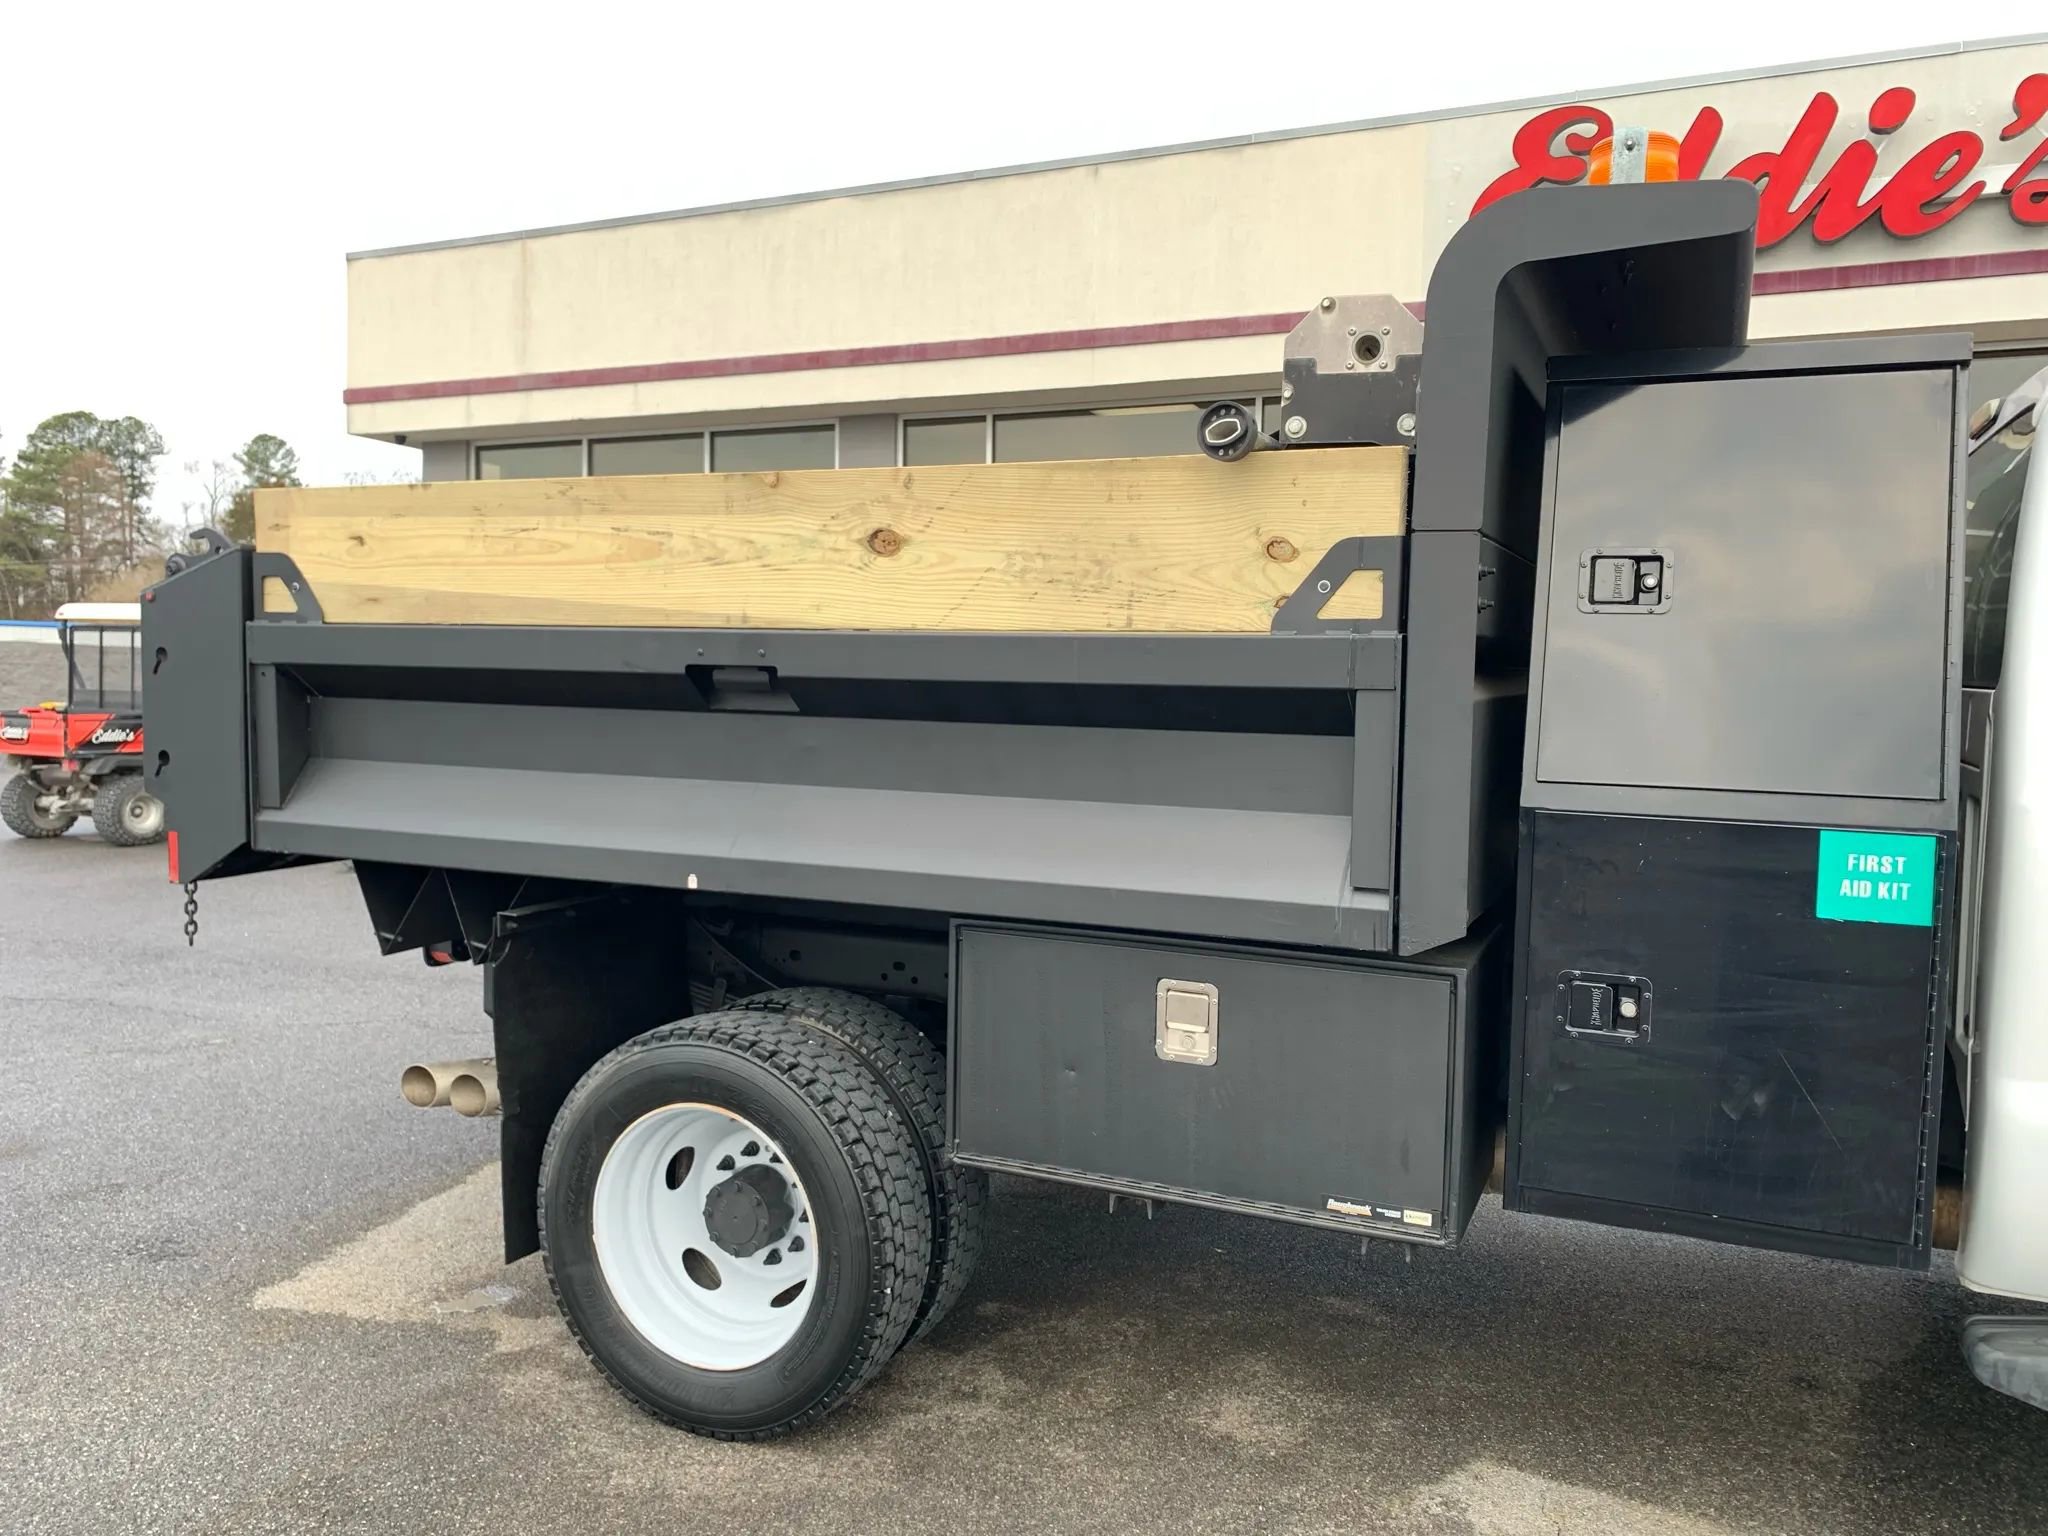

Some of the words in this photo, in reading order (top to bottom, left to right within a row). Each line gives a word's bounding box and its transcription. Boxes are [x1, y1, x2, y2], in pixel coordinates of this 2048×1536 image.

[1468, 73, 2048, 249] Edie'
[1847, 853, 1907, 875] FIRST
[1839, 878, 1873, 899] AID
[1877, 881, 1912, 901] KIT
